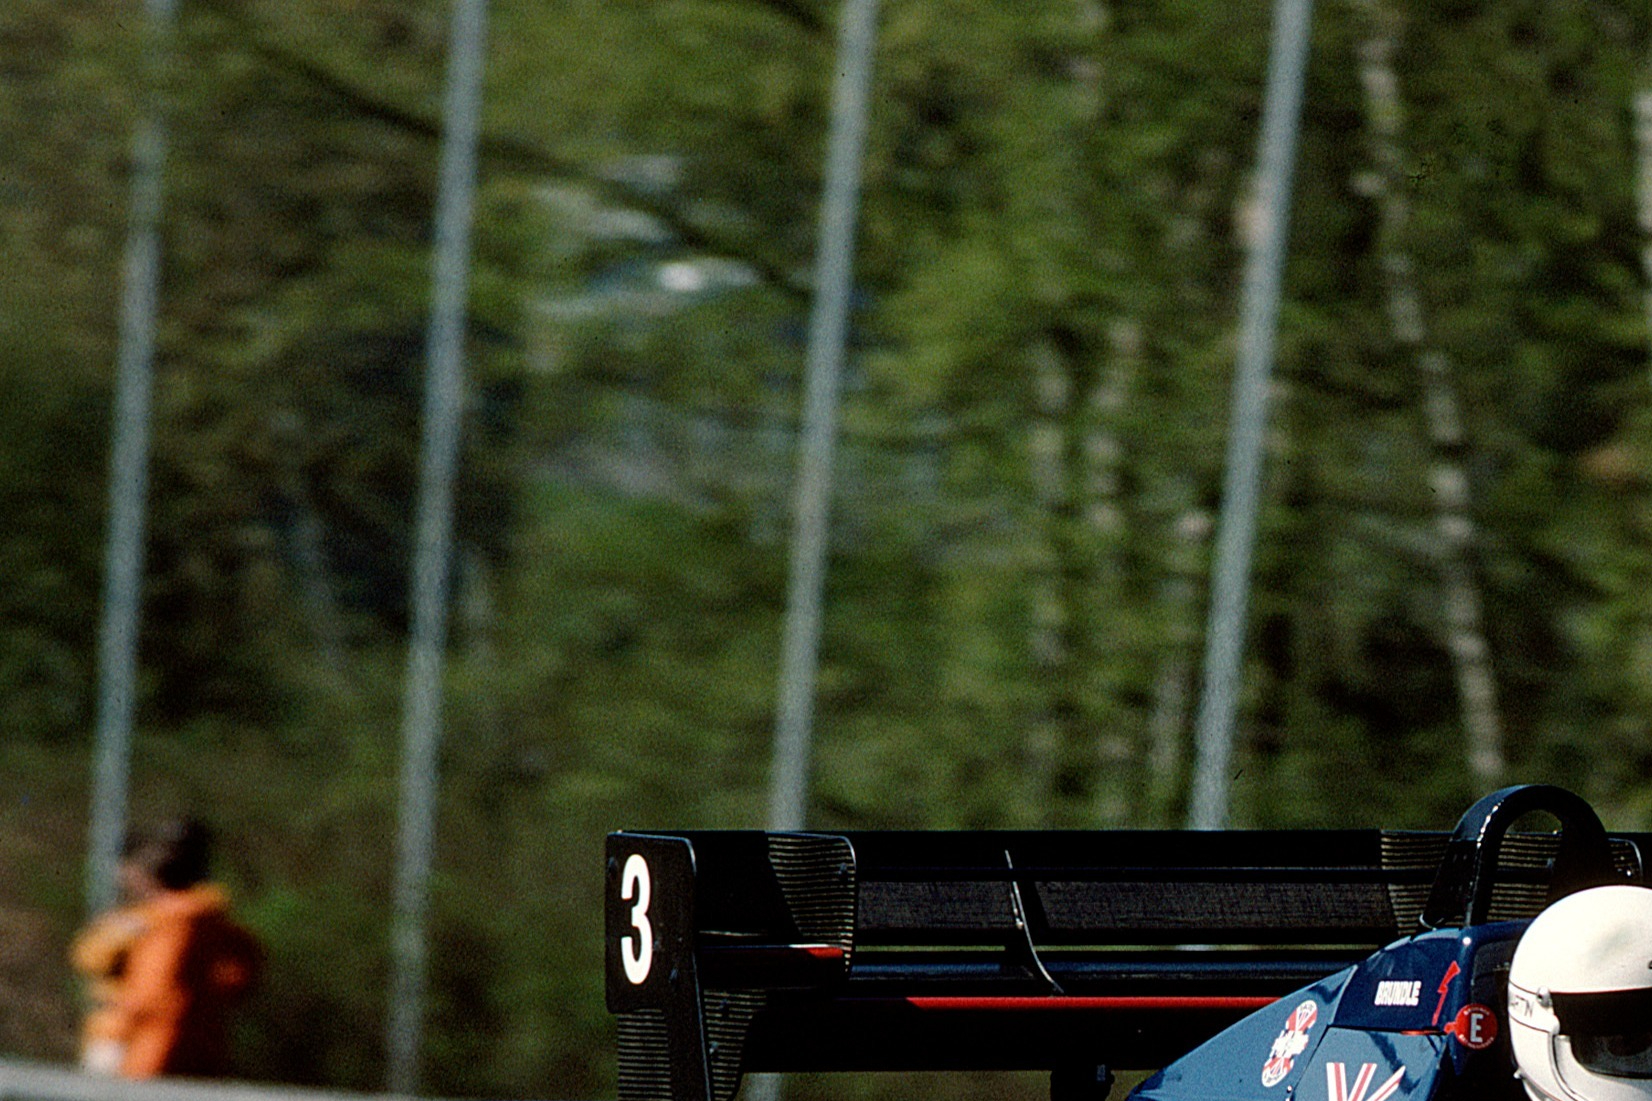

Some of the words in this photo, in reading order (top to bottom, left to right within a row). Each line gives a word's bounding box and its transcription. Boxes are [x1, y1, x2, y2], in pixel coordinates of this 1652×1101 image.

[620, 853, 654, 985] 3
[1374, 980, 1422, 1007] BRUNDLE
[1470, 1012, 1484, 1043] E
